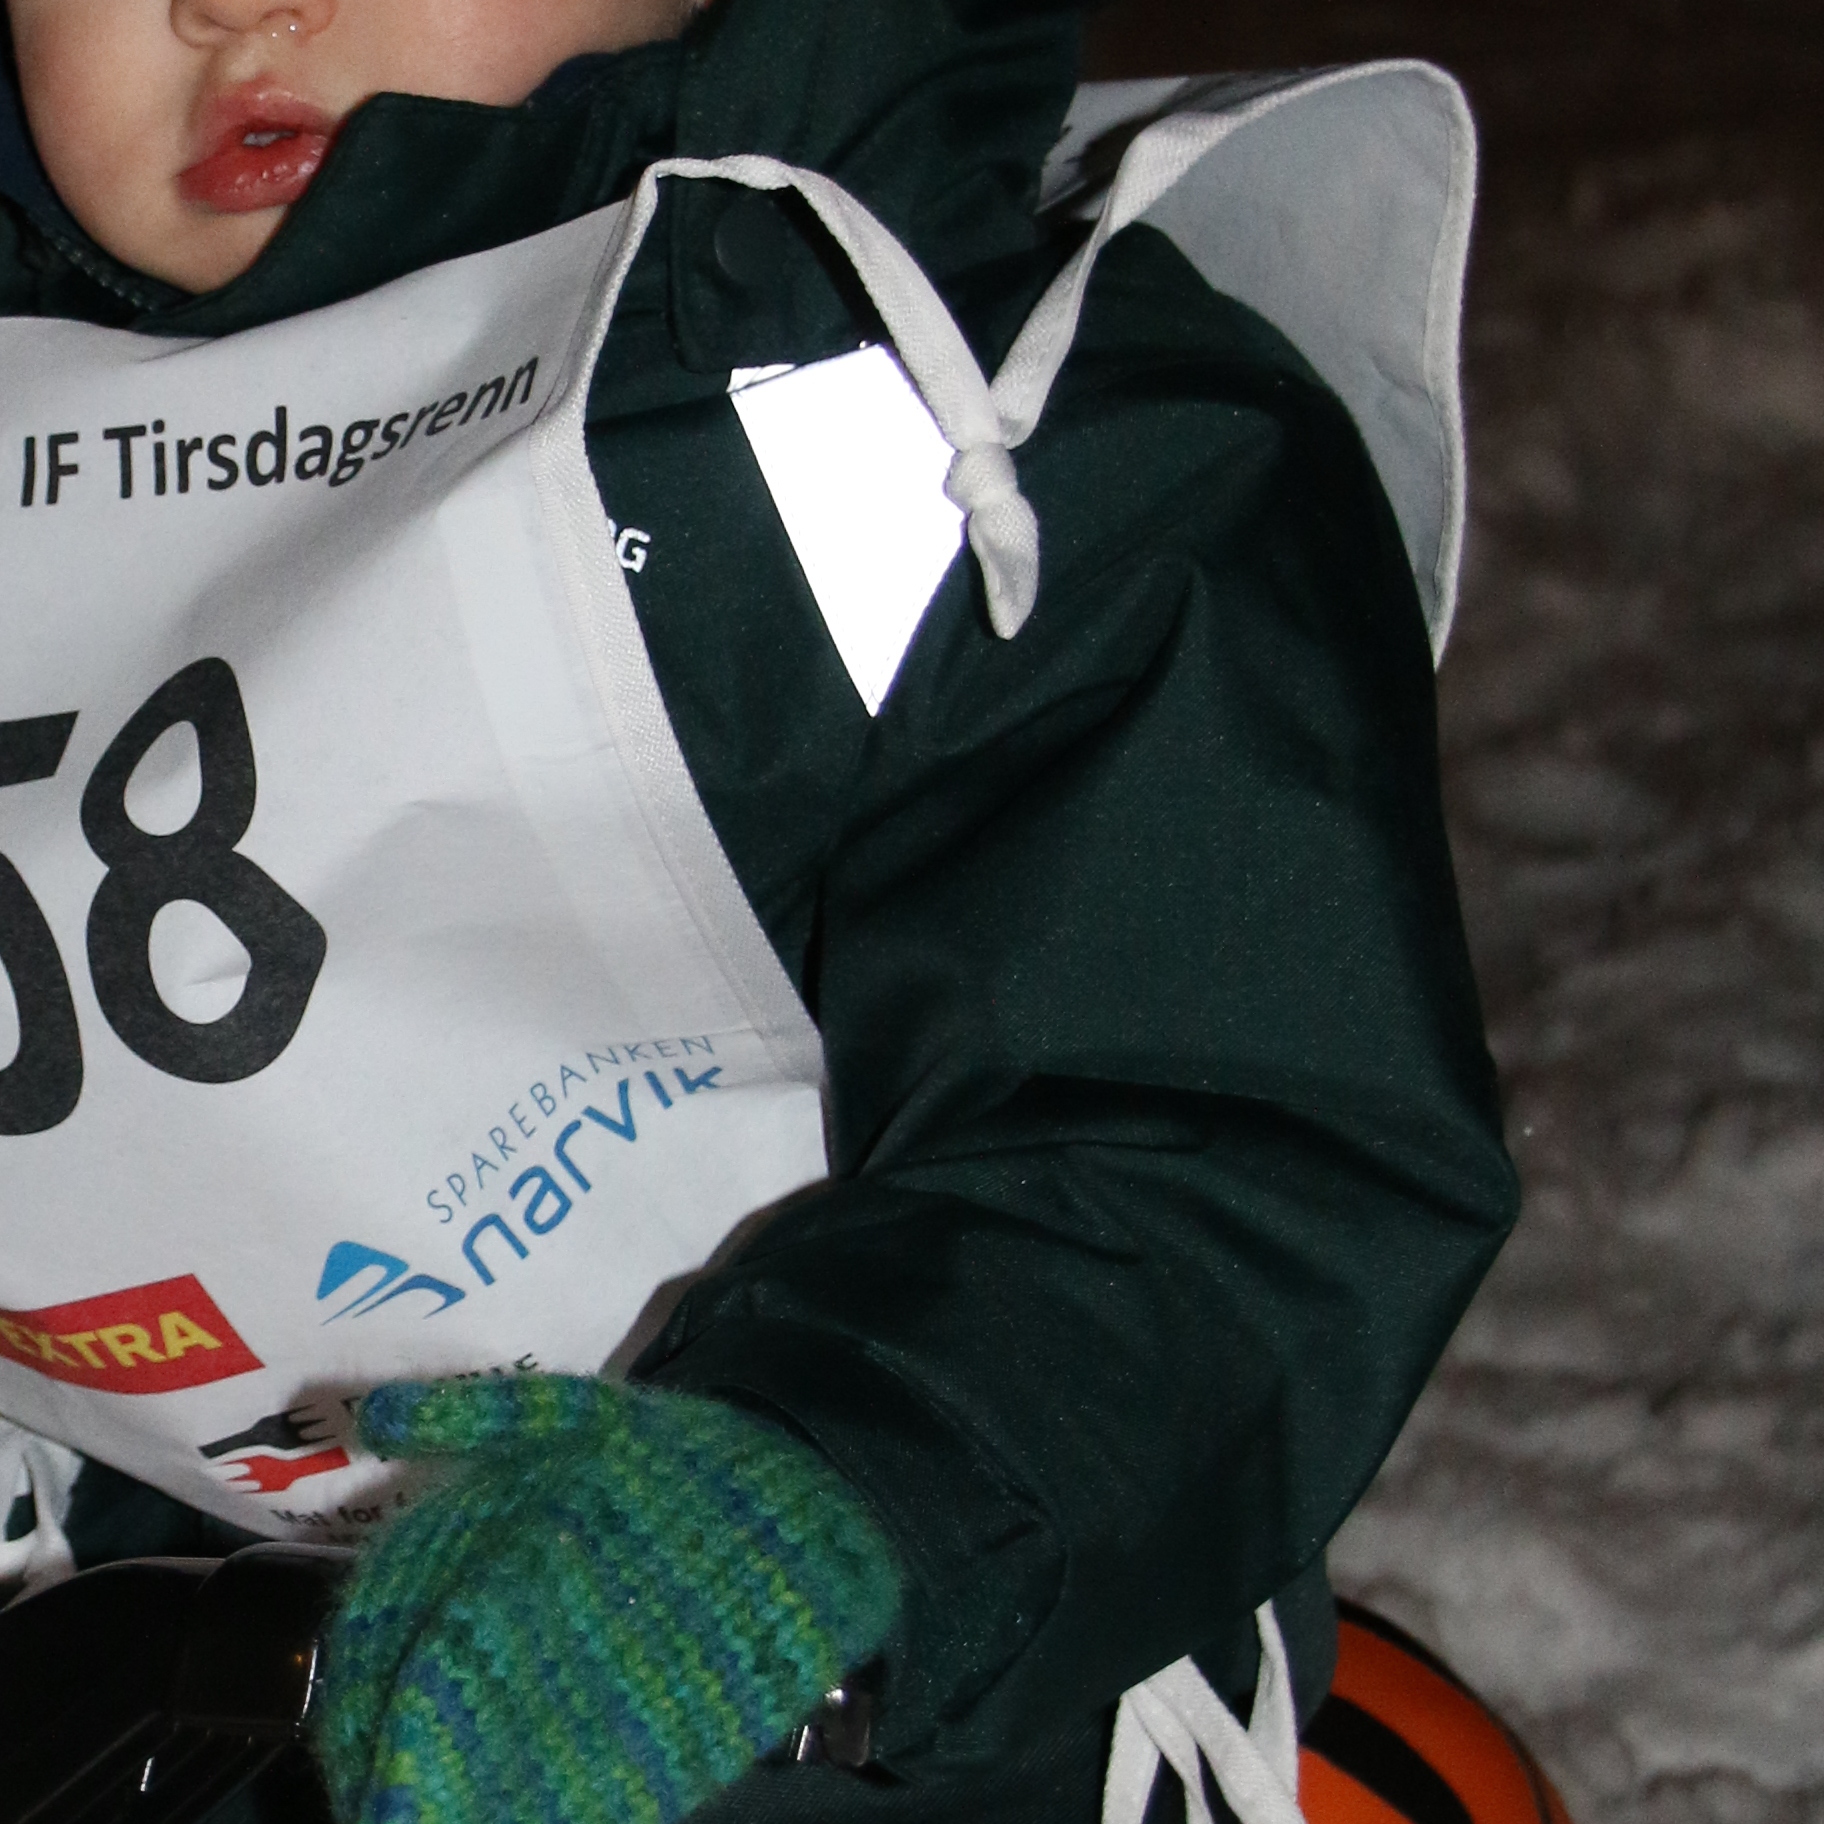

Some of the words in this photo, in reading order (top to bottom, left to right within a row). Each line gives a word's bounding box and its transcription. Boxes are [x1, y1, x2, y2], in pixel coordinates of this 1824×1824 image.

[20, 431, 79, 508] IF
[102, 355, 540, 488] Tirsdagsrenn
[426, 1034, 716, 1225] SPAREBANKEN
